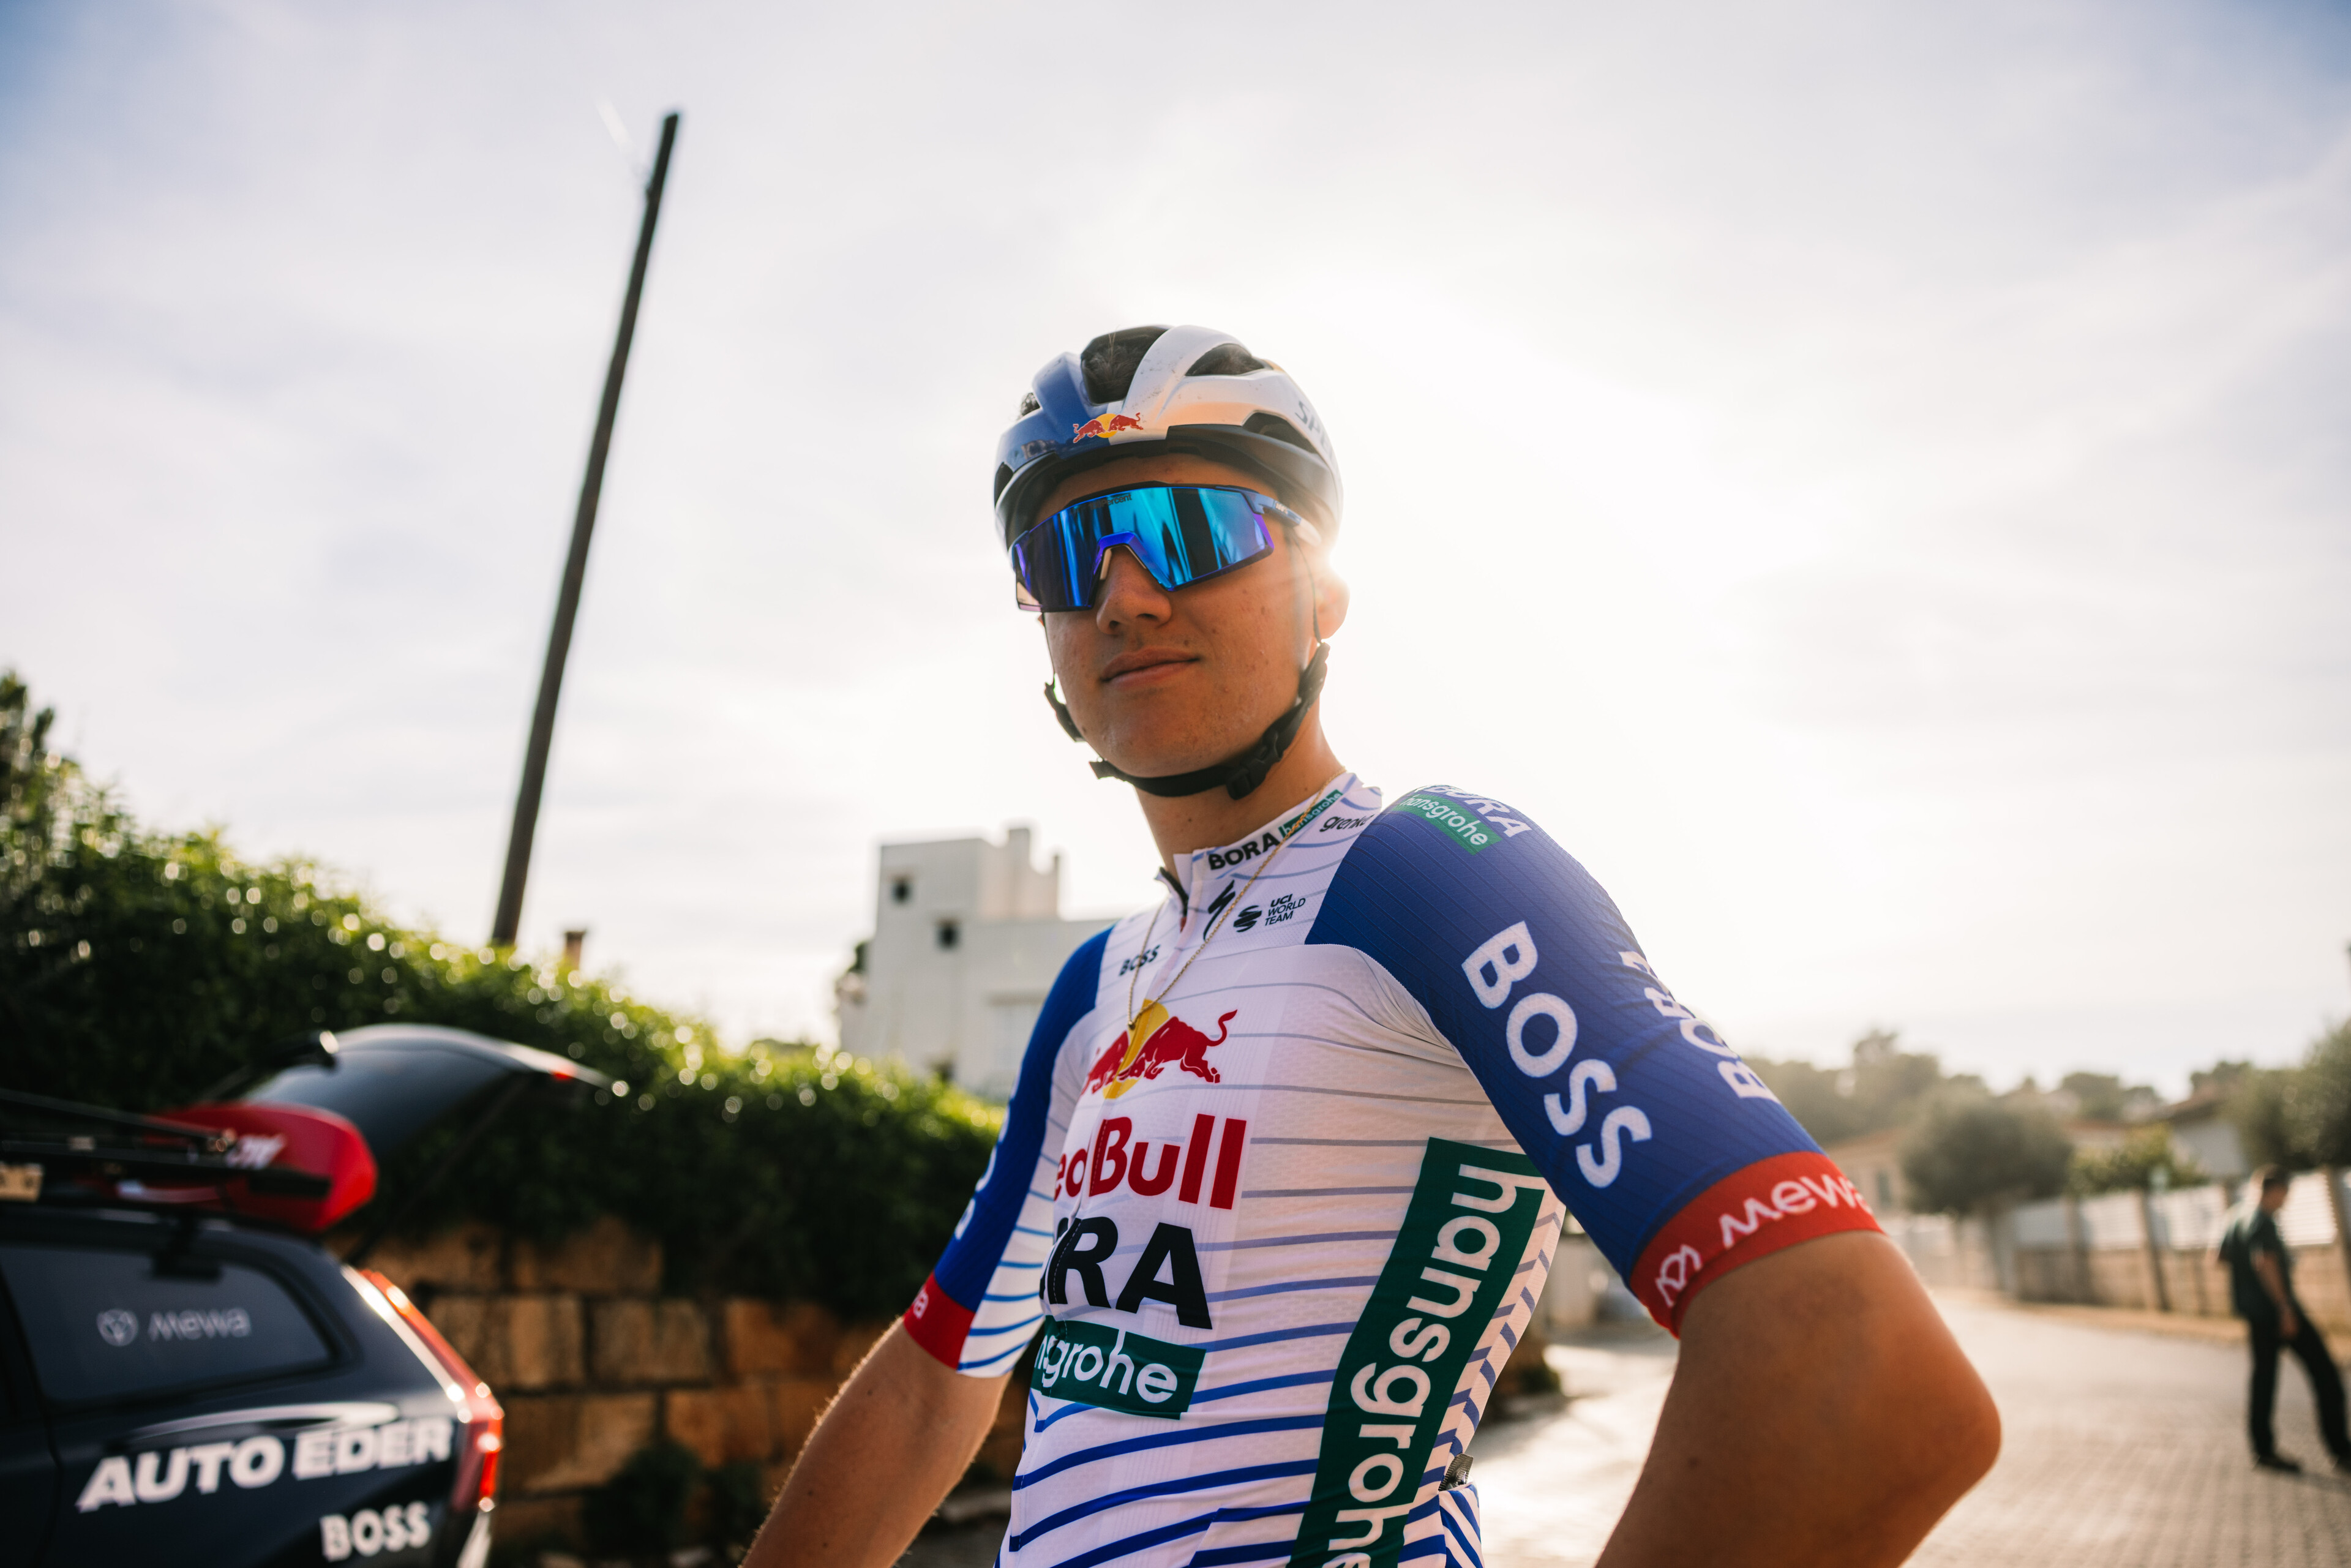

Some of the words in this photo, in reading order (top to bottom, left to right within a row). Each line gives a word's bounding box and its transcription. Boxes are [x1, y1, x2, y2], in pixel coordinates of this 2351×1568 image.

[1400, 793, 1488, 846] hansgrohe
[1208, 832, 1281, 871] BORA
[1265, 910, 1294, 926] TEAM
[1268, 898, 1306, 917] WORLD
[1270, 893, 1292, 907] UCI
[1119, 945, 1161, 976] BOSS
[1461, 920, 1652, 1188] BOSS
[1039, 1217, 1213, 1329] RA
[75, 1435, 286, 1514] AUTO
[292, 1416, 453, 1480] EDER
[320, 1501, 432, 1562] BOSS
